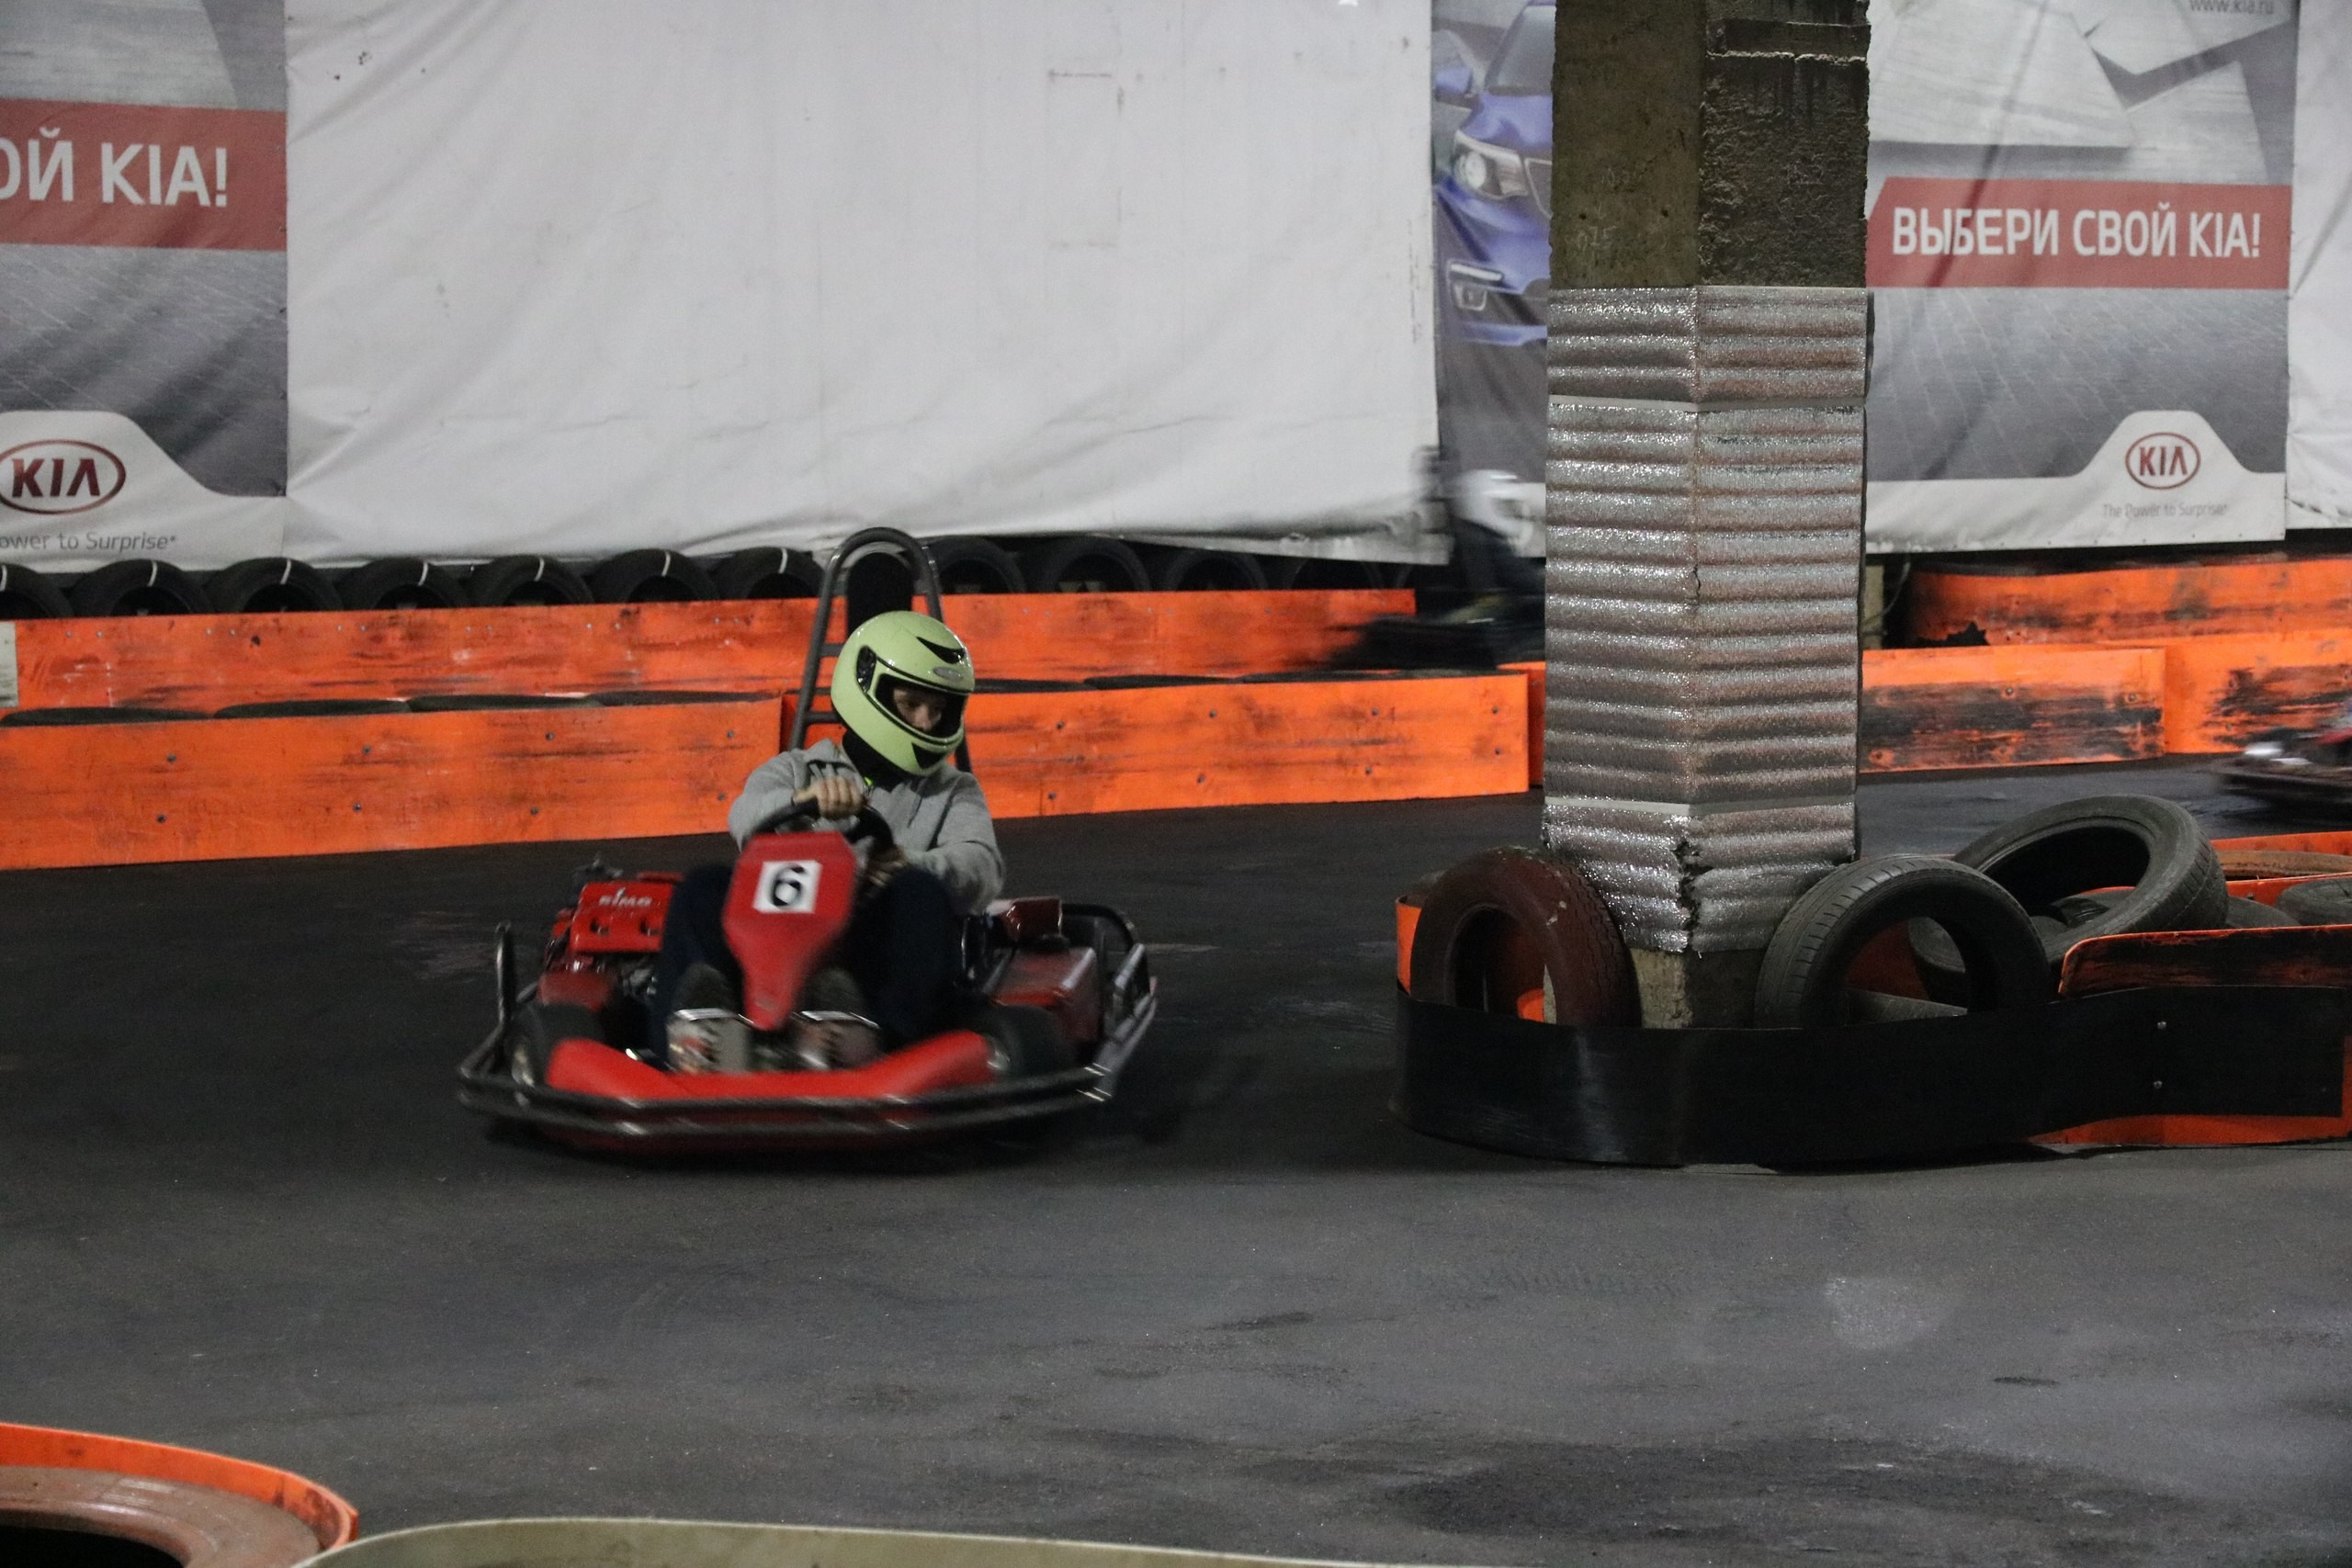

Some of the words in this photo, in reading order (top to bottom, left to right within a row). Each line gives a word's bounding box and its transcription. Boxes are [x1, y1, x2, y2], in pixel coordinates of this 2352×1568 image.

[101, 141, 228, 208] KIA!
[1893, 207, 2059, 255] ВЫБЕРИ
[2073, 201, 2177, 256] СВОЙ
[2189, 211, 2261, 258] KIA!
[12, 457, 100, 498] KIA
[2139, 446, 2188, 476] KIA
[2104, 503, 2122, 517] The
[2165, 503, 2176, 516] to
[58, 533, 79, 550] to
[771, 864, 807, 909] 6
